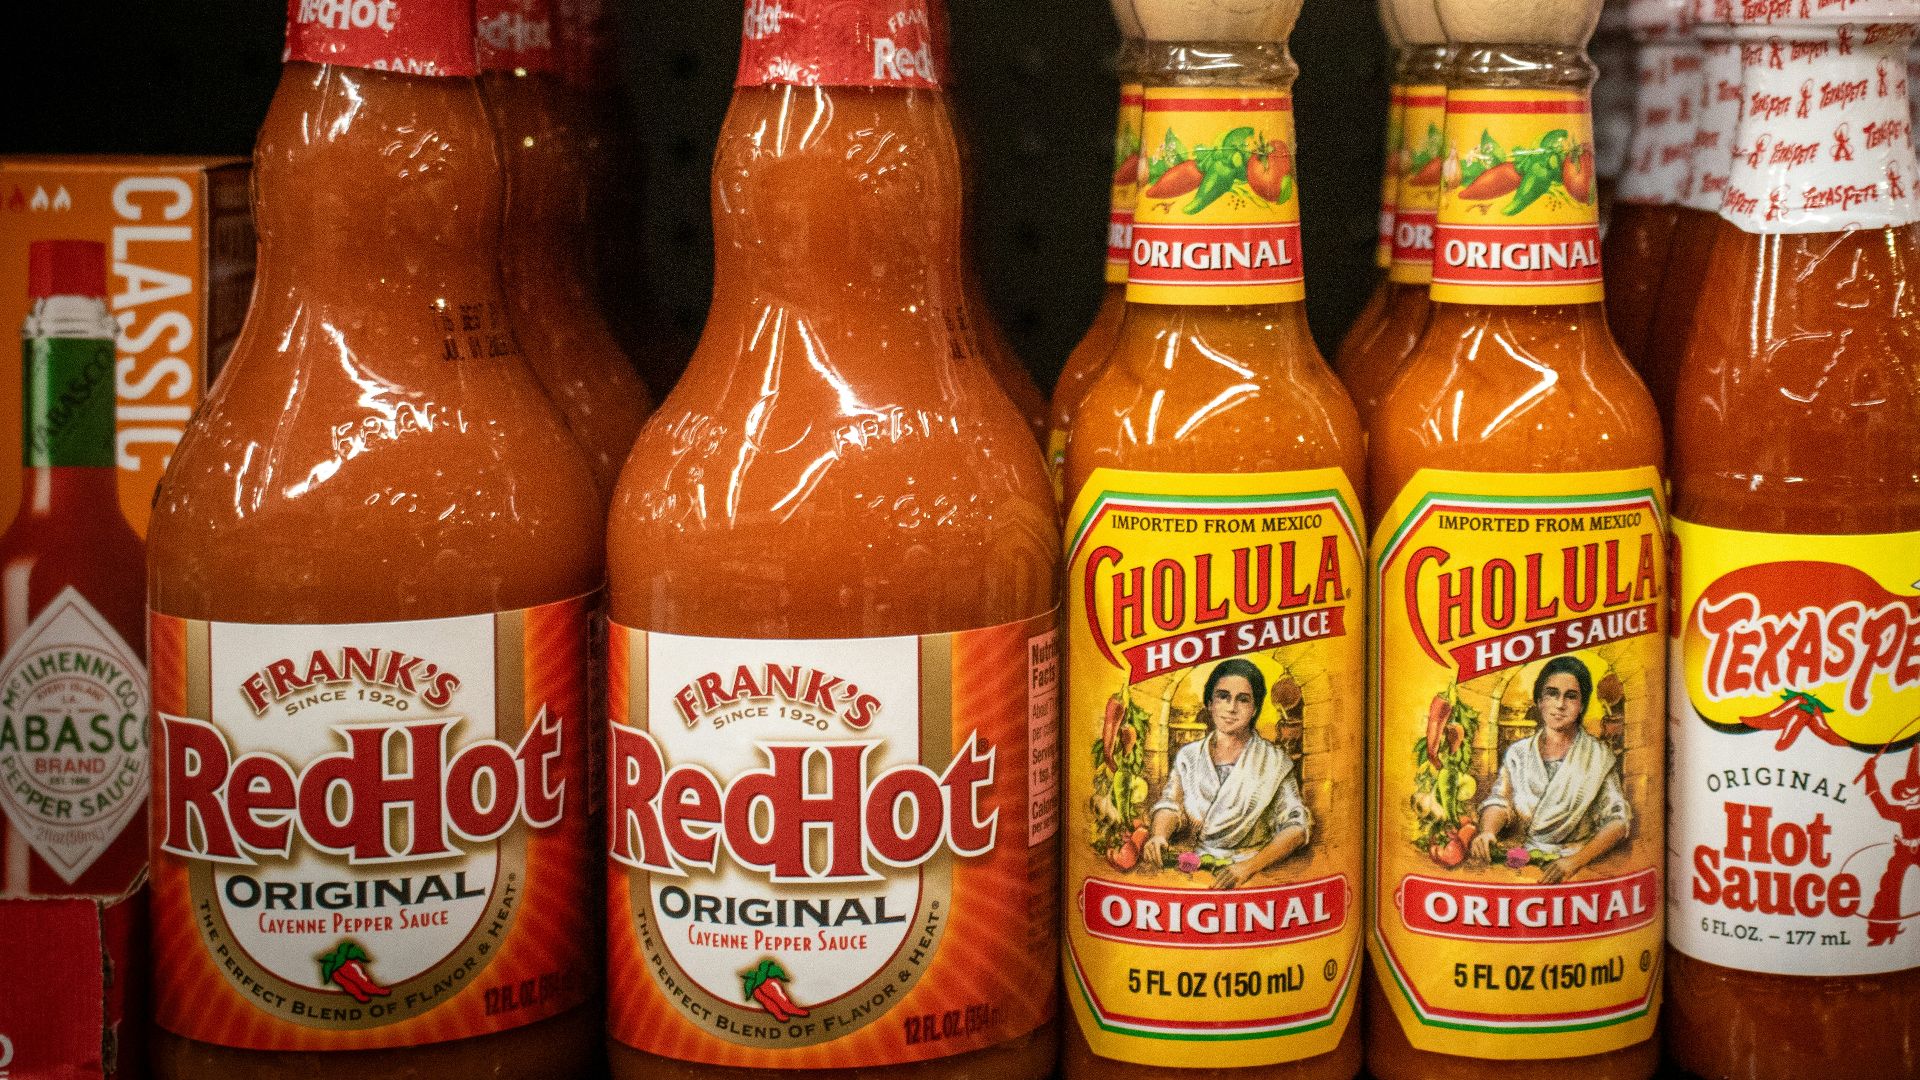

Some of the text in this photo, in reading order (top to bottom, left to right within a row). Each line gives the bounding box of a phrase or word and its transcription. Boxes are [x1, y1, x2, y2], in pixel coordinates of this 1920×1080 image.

[1133, 238, 1293, 270] ORIGINAL
[1444, 239, 1600, 271] ORIGINAL
[112, 177, 194, 472] CLASSIC
[1111, 514, 1322, 534] IMPORTED FROM MEXICO
[1438, 512, 1642, 533] IMPORTED FROM MEXICO
[1084, 535, 1346, 670] CHOLULA
[1404, 533, 1658, 670] CHOLULA
[1146, 611, 1331, 674] HOT SAUCE
[1475, 607, 1649, 673] HOT SAUCE
[241, 646, 461, 715] FRANK'S
[287, 688, 409, 716] SINCE 1920
[673, 662, 882, 729] FRANK'S
[0, 713, 149, 753] ABASC
[713, 706, 829, 731] SINCE 1920
[1, 755, 140, 819] PEPPER SAUCE
[35, 757, 106, 775] BRAND
[158, 702, 566, 866] RedHot
[1707, 767, 1848, 804] ORIGINAL
[609, 729, 999, 883] RedHot
[1723, 801, 1832, 869] Hot
[225, 871, 486, 911] ORIGINAL
[1692, 843, 1861, 918] Sauce
[258, 908, 449, 934] CAYENNE PEPPER SAUCE
[658, 885, 907, 928] ORIGINAL
[1101, 891, 1332, 934] ORIGINAL
[1423, 883, 1648, 929] ORIGINAL
[688, 923, 868, 951] CAYENNE PEPPER SAUCE
[1701, 917, 1709, 932] 6
[1785, 930, 1816, 946] 177
[1820, 930, 1851, 946] mL
[201, 901, 220, 943] THE
[216, 944, 287, 1009] PERFECT
[290, 1001, 363, 1022] BLEND
[369, 1001, 398, 1018] OF
[403, 957, 478, 1009] FLAVOR
[478, 941, 492, 956] &
[638, 908, 654, 951] THE
[651, 952, 713, 1021] PERFECT
[715, 1014, 782, 1040] BLEND
[787, 1023, 816, 1039] OF
[823, 983, 899, 1032] FLAVOR
[898, 969, 912, 983] &
[1127, 963, 1305, 998] 5 FL OZ (150 mL)
[1453, 955, 1625, 991] 5 FL OZ (150 mL)
[904, 1015, 921, 1046] 12
